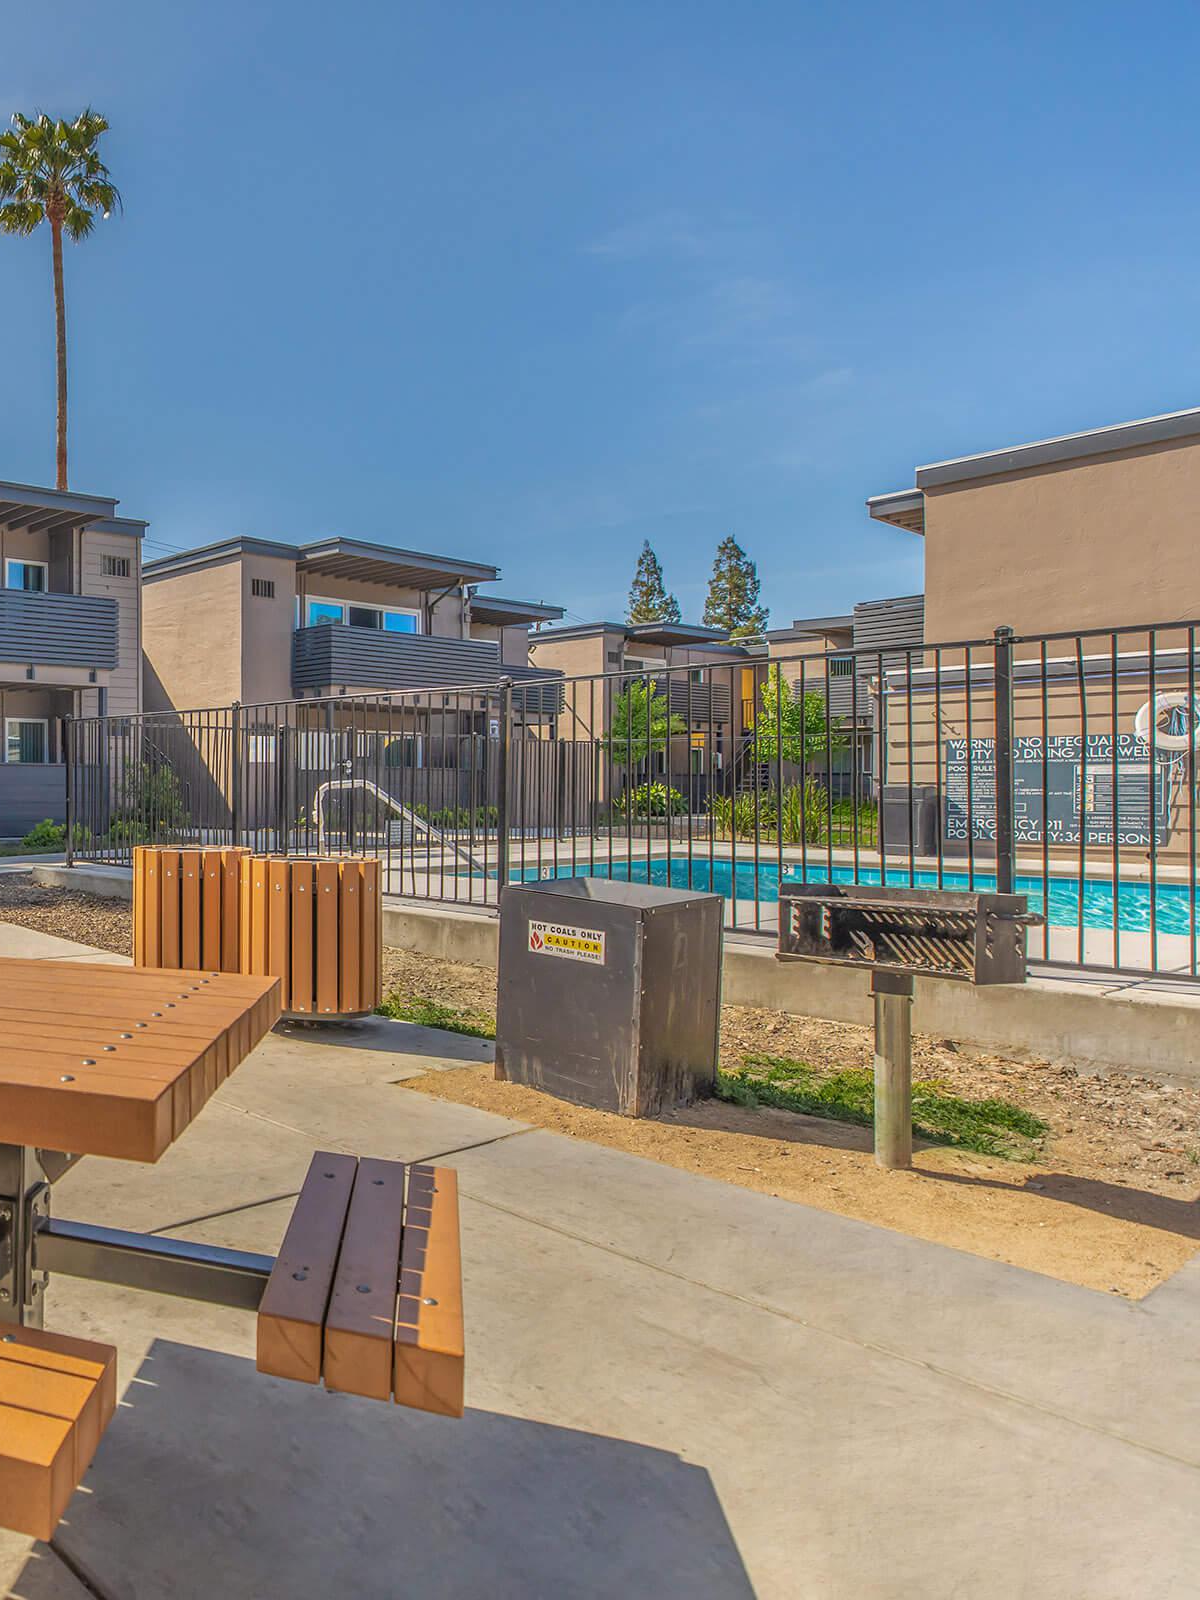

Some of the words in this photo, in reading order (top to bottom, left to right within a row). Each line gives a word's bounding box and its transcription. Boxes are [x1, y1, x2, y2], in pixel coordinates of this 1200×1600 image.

[1018, 737, 1042, 748] NO
[956, 749, 992, 760] DUTY
[948, 819, 1038, 829] EMERGCY
[948, 829, 987, 839] POOL
[531, 922, 547, 932] HOT
[550, 926, 576, 937] COALS
[580, 931, 602, 941] ONLY
[546, 936, 599, 951] CAUTION
[556, 947, 575, 955] TRASH
